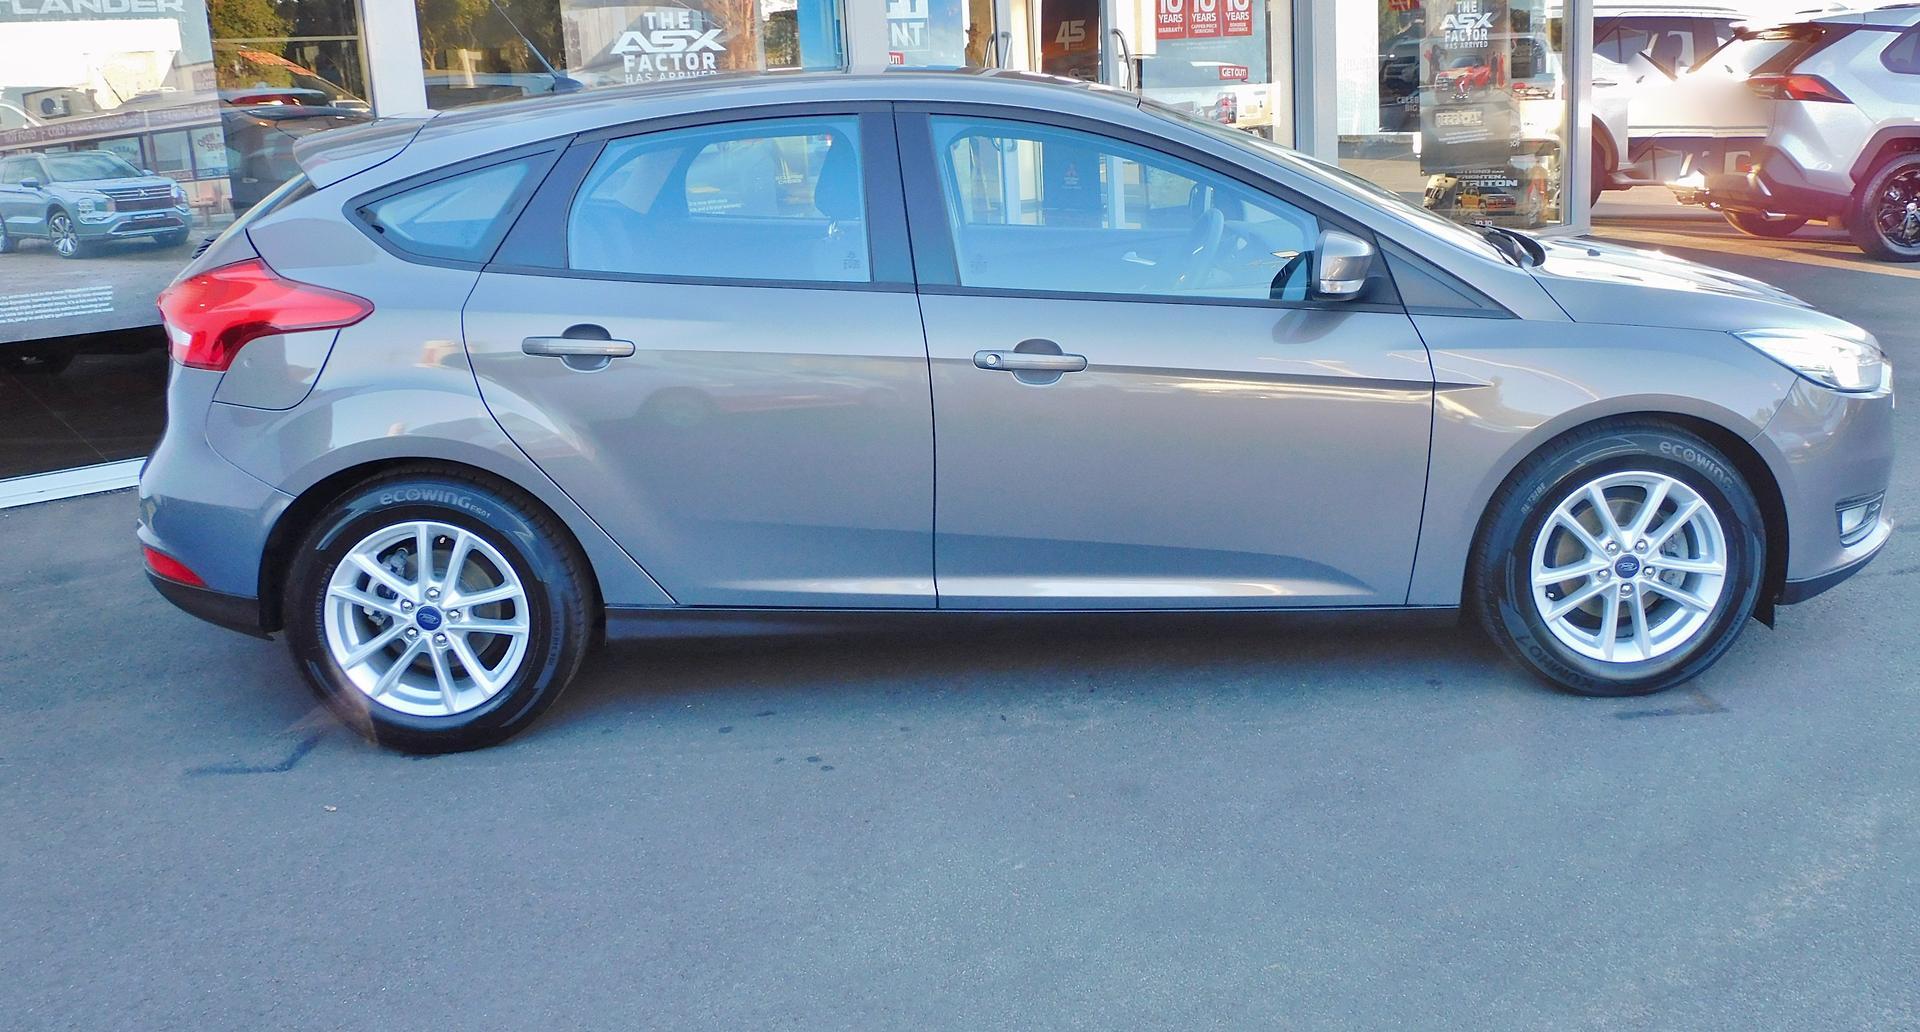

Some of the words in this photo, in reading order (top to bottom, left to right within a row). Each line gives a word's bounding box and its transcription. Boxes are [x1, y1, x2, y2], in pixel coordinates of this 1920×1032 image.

[0, 0, 187, 14] LANDER
[1160, 0, 1183, 14] 10
[1191, 0, 1216, 12] 10
[1227, 0, 1249, 12] 10
[1457, 0, 1477, 13] THE
[643, 10, 691, 30] THE
[1159, 14, 1183, 23] YEARS
[1192, 13, 1217, 22] YEARS
[1226, 12, 1250, 21] YEARS
[1440, 12, 1494, 30] ASX
[1055, 20, 1086, 51] 45
[1444, 28, 1488, 42] FACTOR
[609, 28, 727, 55] ASX
[1460, 40, 1488, 49] ARRIVED
[624, 52, 717, 73] FACTOR
[625, 73, 652, 84] HAS
[1221, 68, 1234, 77] GET
[1459, 179, 1518, 187] TRITON
